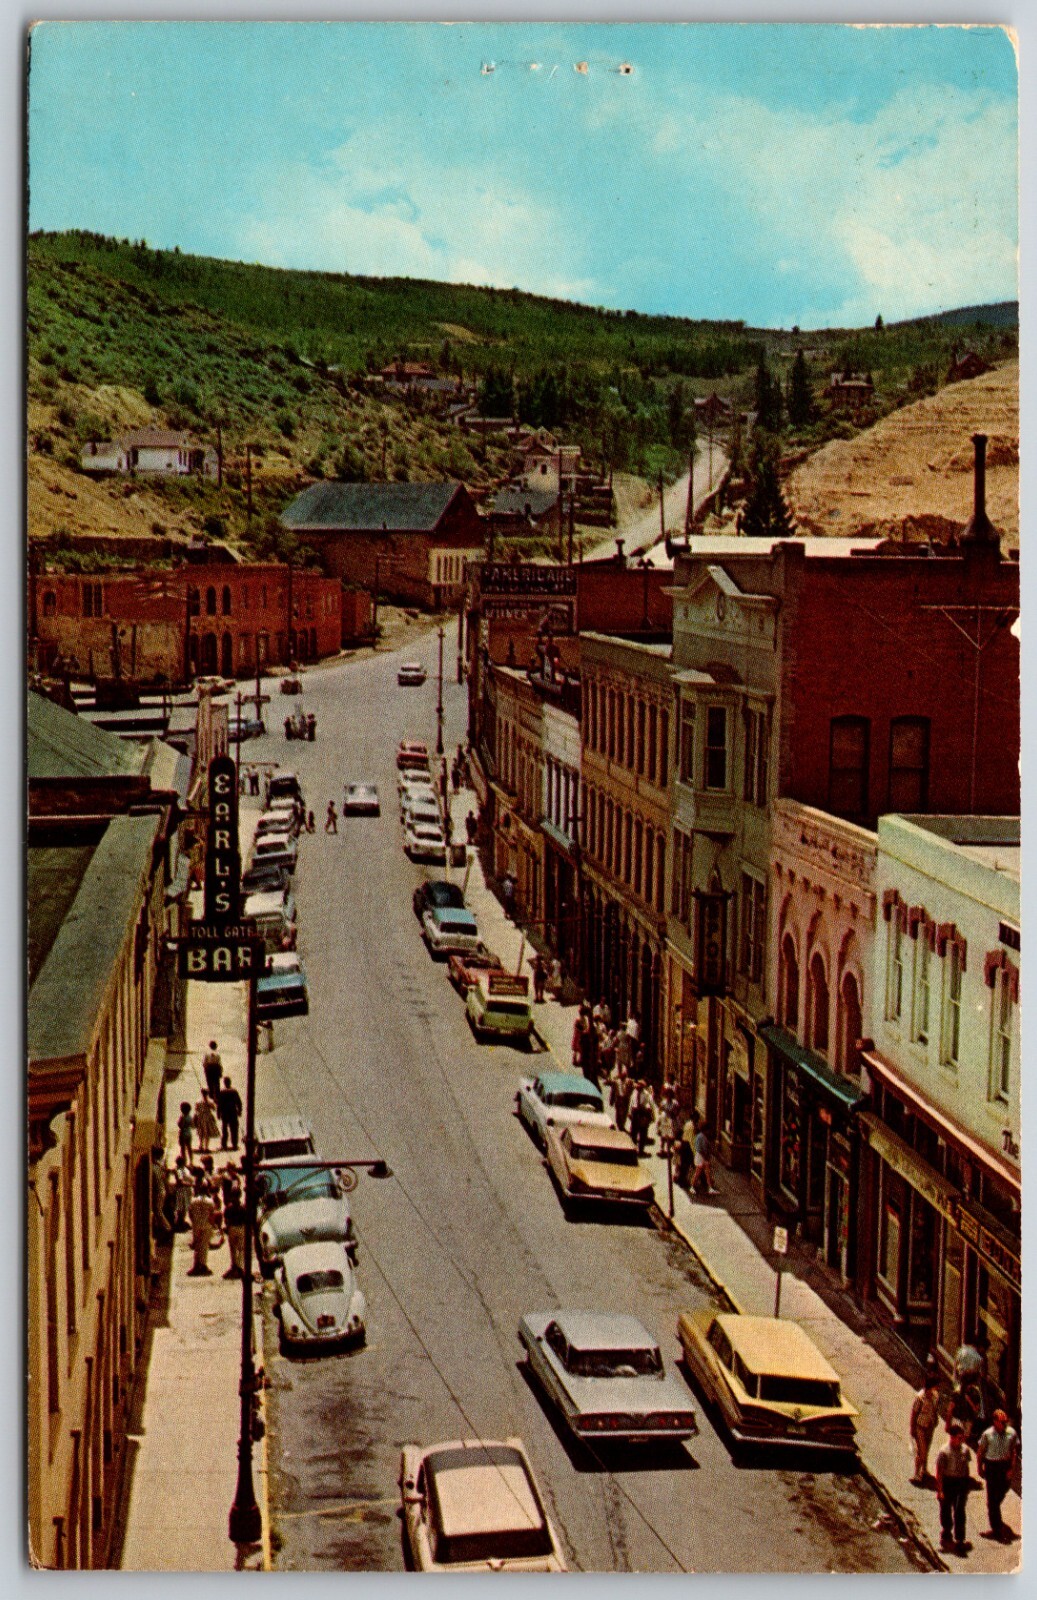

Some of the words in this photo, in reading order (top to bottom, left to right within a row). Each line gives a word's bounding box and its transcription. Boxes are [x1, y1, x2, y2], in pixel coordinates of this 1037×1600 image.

[213, 773, 230, 912] EARL'S
[191, 926, 218, 938] TOLL
[224, 926, 254, 938] GATE
[187, 946, 252, 972] BAR
